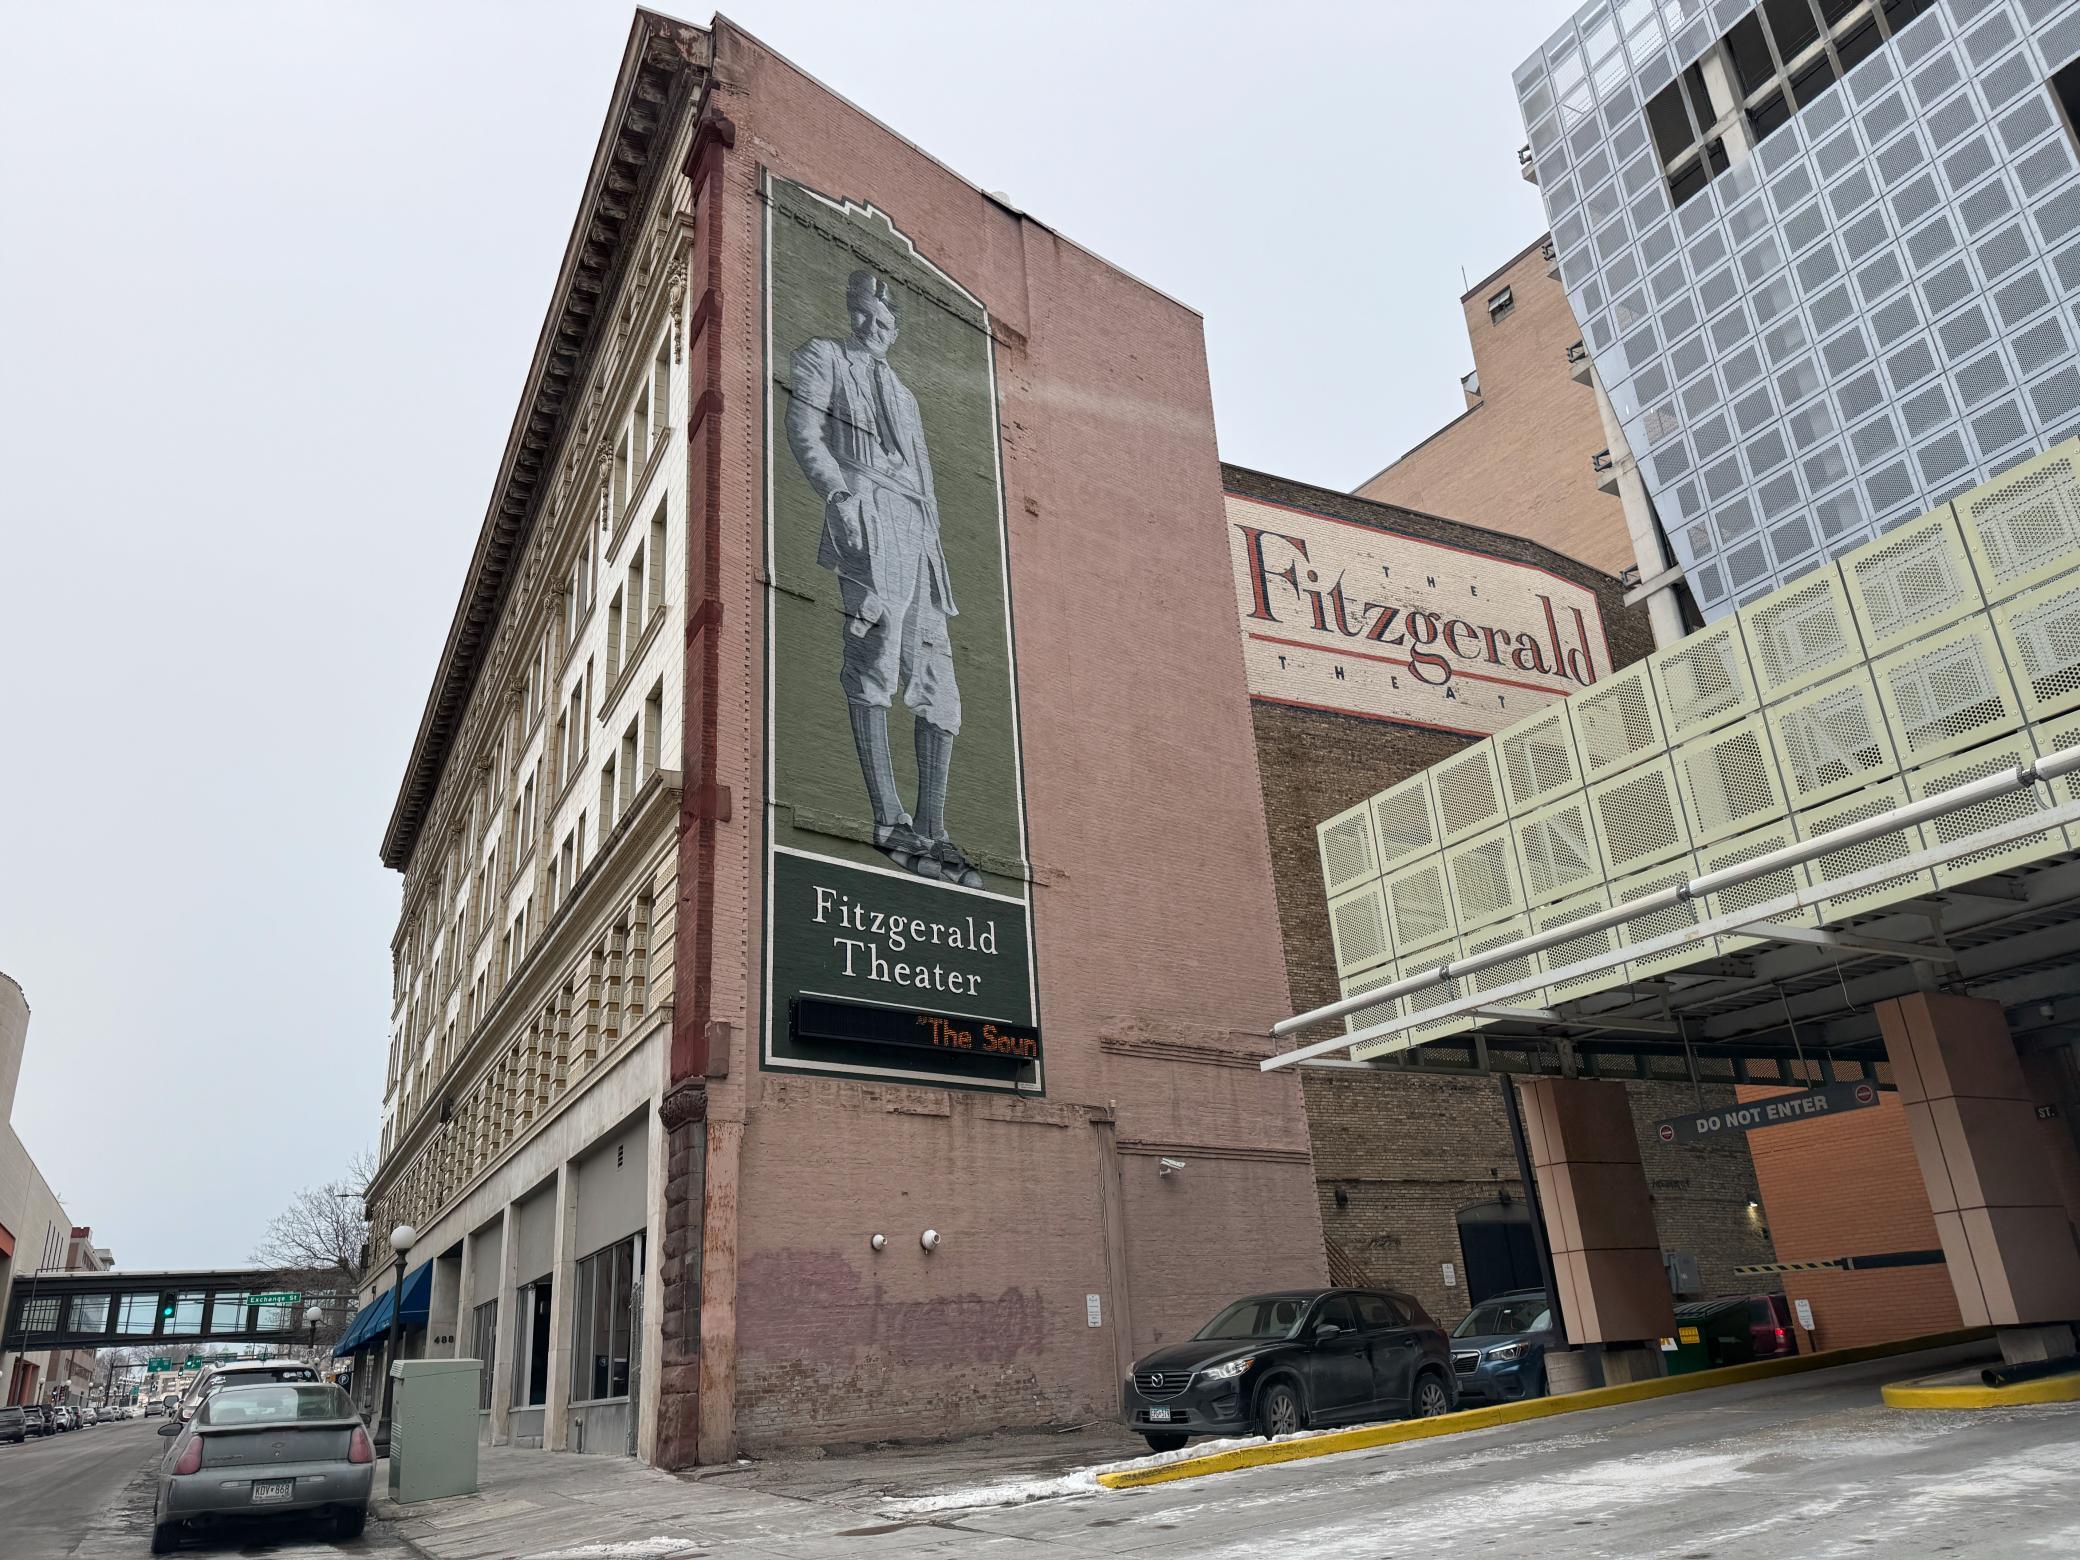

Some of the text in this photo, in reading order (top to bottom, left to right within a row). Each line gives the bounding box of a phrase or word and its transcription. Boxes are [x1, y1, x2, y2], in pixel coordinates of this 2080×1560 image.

[1233, 524, 1597, 687] Fitzgerald
[1382, 566, 1478, 597] THE
[812, 885, 998, 955] Fitzgerald
[834, 937, 982, 996] Theater
[983, 1024, 1037, 1057] Soun
[1696, 1116, 1721, 1133] DO
[1725, 1108, 1762, 1128] NOT
[1765, 1095, 1828, 1120] ENTER
